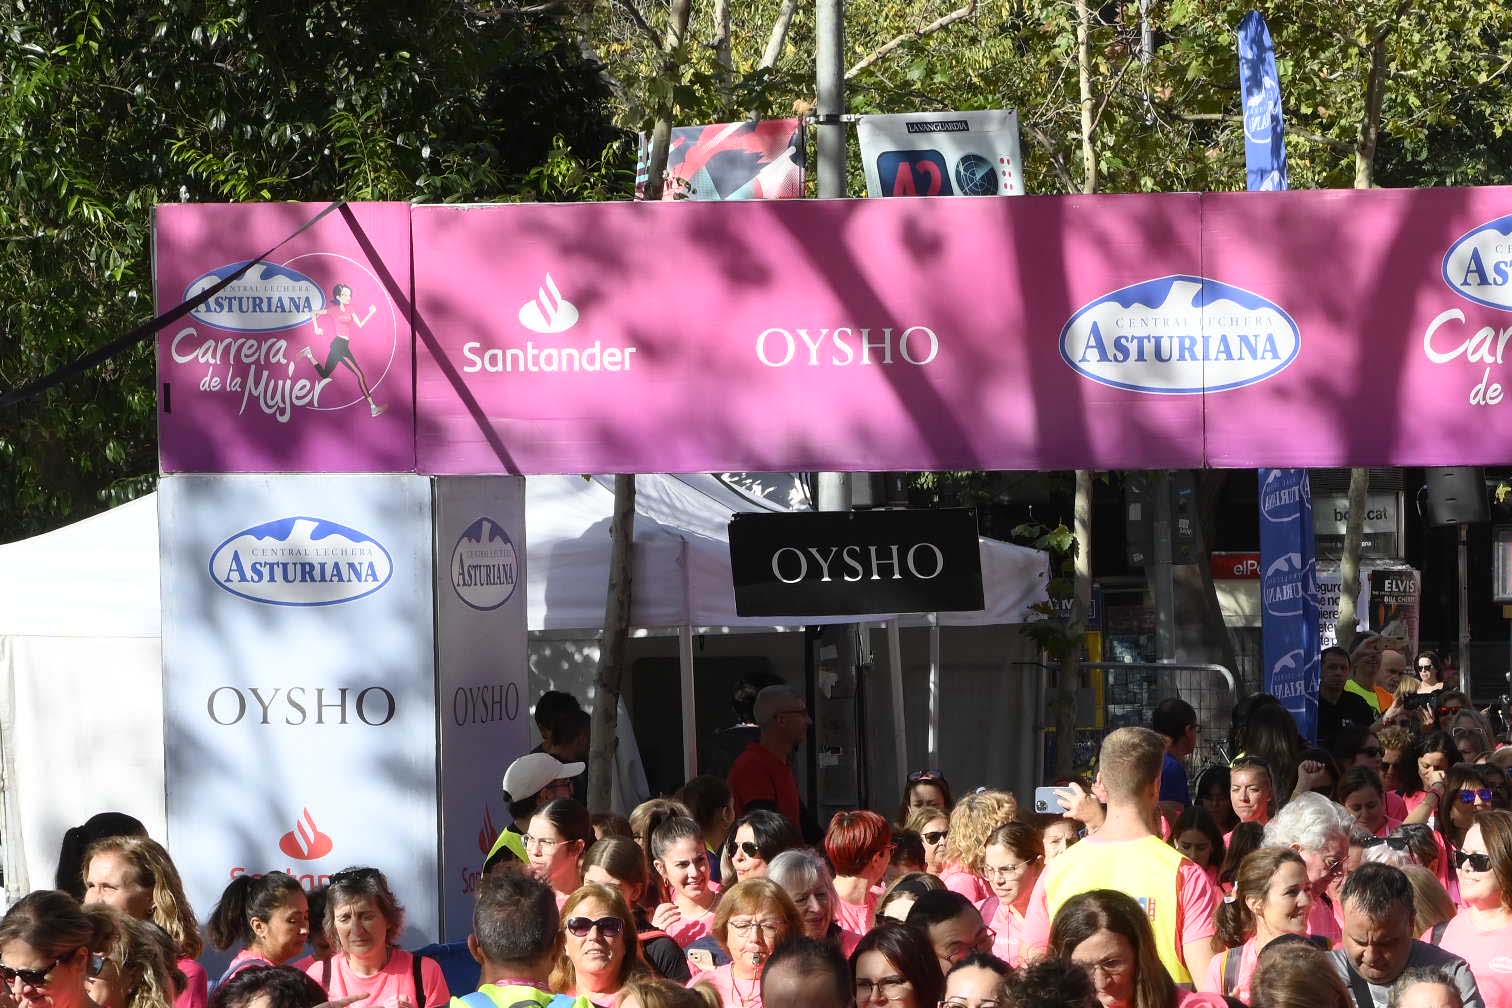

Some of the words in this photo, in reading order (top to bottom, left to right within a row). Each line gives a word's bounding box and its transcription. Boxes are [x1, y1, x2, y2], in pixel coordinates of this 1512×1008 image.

[1115, 315, 1195, 328] CENTRAL
[1199, 315, 1275, 327] LECHERA
[171, 327, 288, 364] Carrera
[463, 343, 636, 373] Santander
[755, 326, 939, 367] OYSHO
[1078, 319, 1282, 364] ASTURIANA
[200, 365, 222, 392] de
[227, 365, 241, 391] la
[239, 361, 333, 423] Mujer
[1469, 367, 1504, 407] de
[223, 550, 380, 584] ASTURIANA
[251, 548, 308, 557] CENTRAL
[315, 547, 374, 556] LECHERA
[457, 552, 514, 587] ASTURIANA
[771, 542, 945, 584] OYSHO
[1385, 580, 1415, 592] ELVIS
[206, 686, 396, 726] OYSHO
[454, 682, 519, 726] OYSHO
